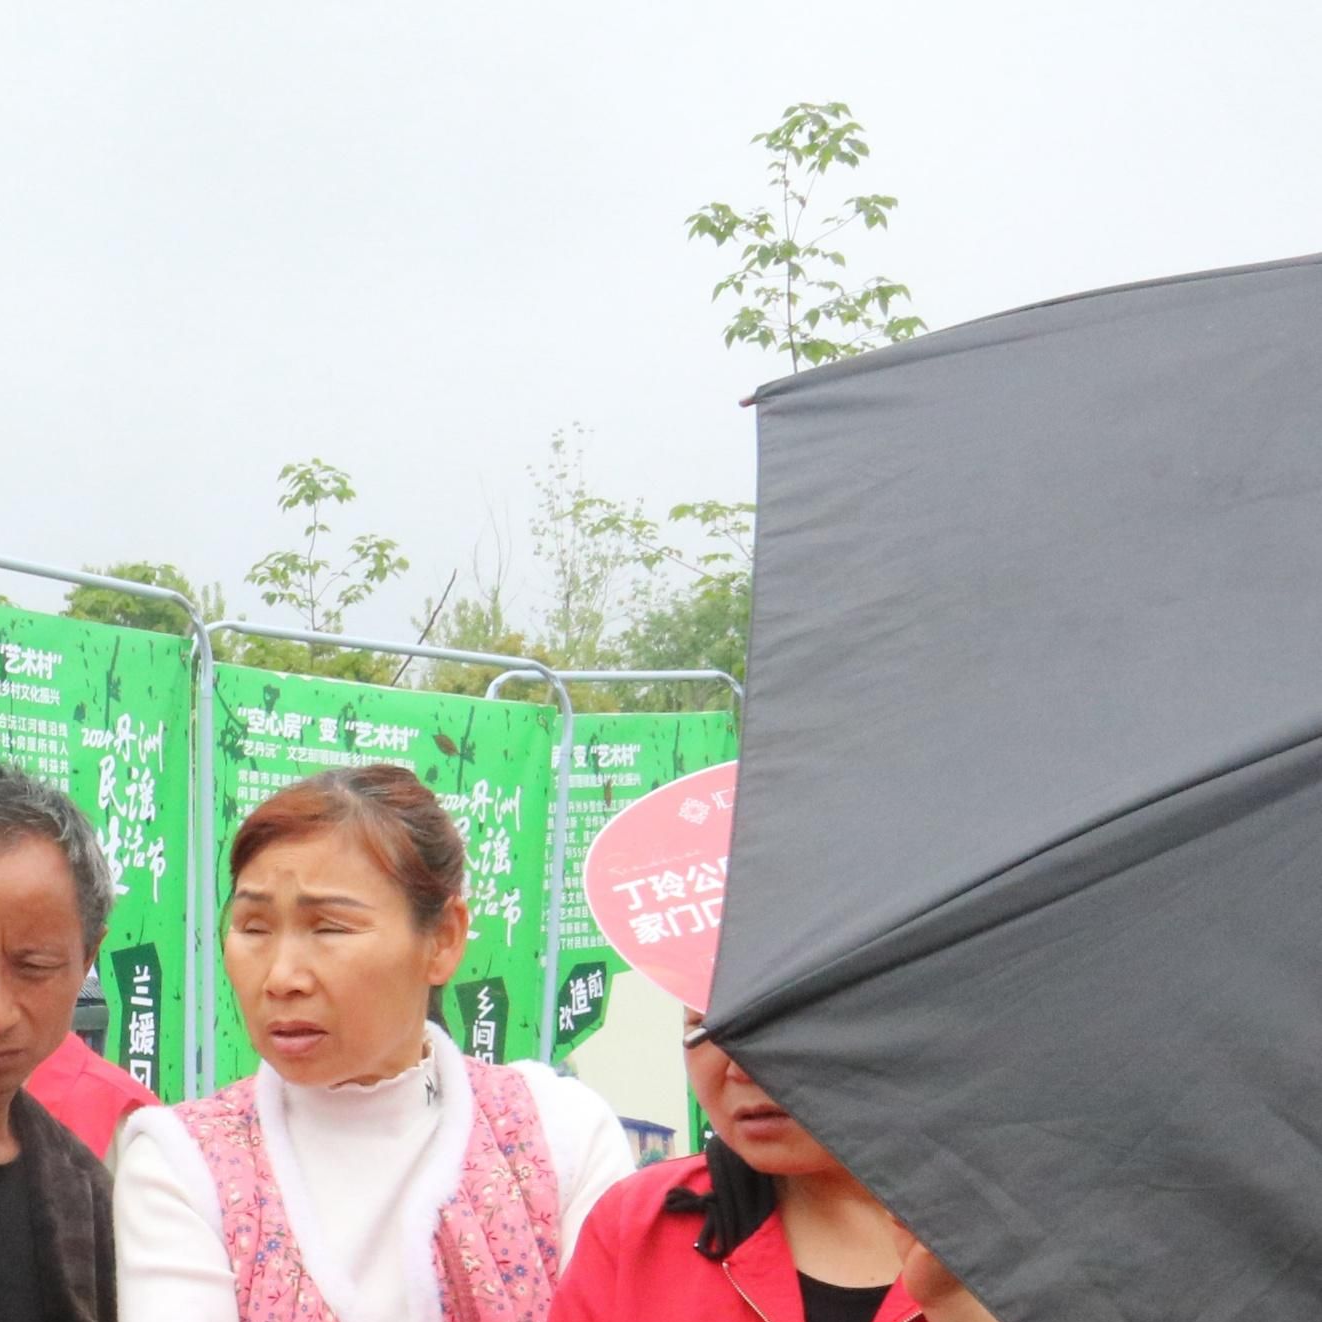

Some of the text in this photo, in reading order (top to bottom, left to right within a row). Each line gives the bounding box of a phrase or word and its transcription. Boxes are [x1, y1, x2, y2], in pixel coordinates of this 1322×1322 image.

[98, 755, 155, 822] 民谣
[559, 970, 604, 1030] 改造前
